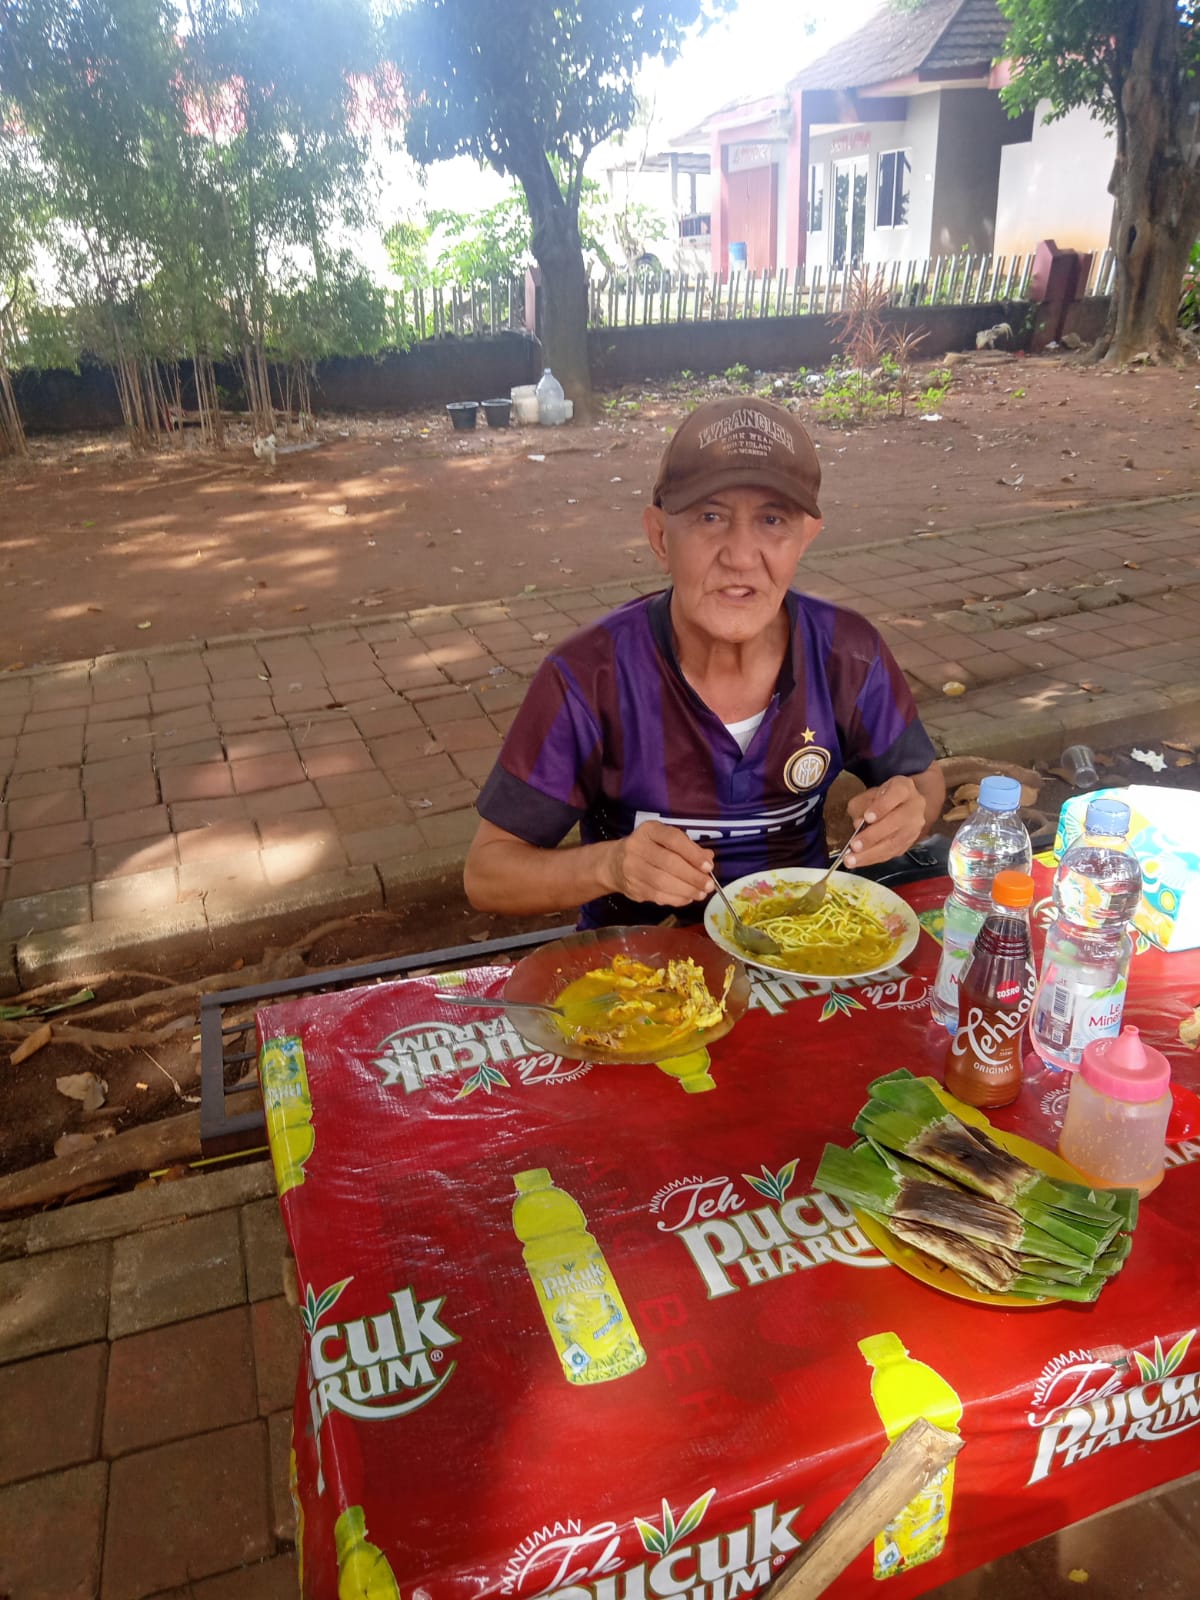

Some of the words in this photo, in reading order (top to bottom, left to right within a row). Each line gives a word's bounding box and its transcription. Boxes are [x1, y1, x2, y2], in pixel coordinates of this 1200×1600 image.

[699, 409, 795, 454] WRANGLER
[997, 986, 1020, 999] SOSRO
[370, 1032, 545, 1094] ucuk
[973, 1062, 1014, 1075] ORIGINAL
[648, 1175, 704, 1214] MINUMAN
[656, 1176, 746, 1232] Teh
[675, 1191, 858, 1299] pucu
[738, 1224, 894, 1286] HARU
[310, 1285, 462, 1380] cuk
[318, 1350, 457, 1420] RUM
[1027, 1360, 1126, 1427] Teh
[1031, 1348, 1094, 1406] MINUMAN
[1026, 1373, 1200, 1487] pucu
[500, 1518, 581, 1595] MINUMAN
